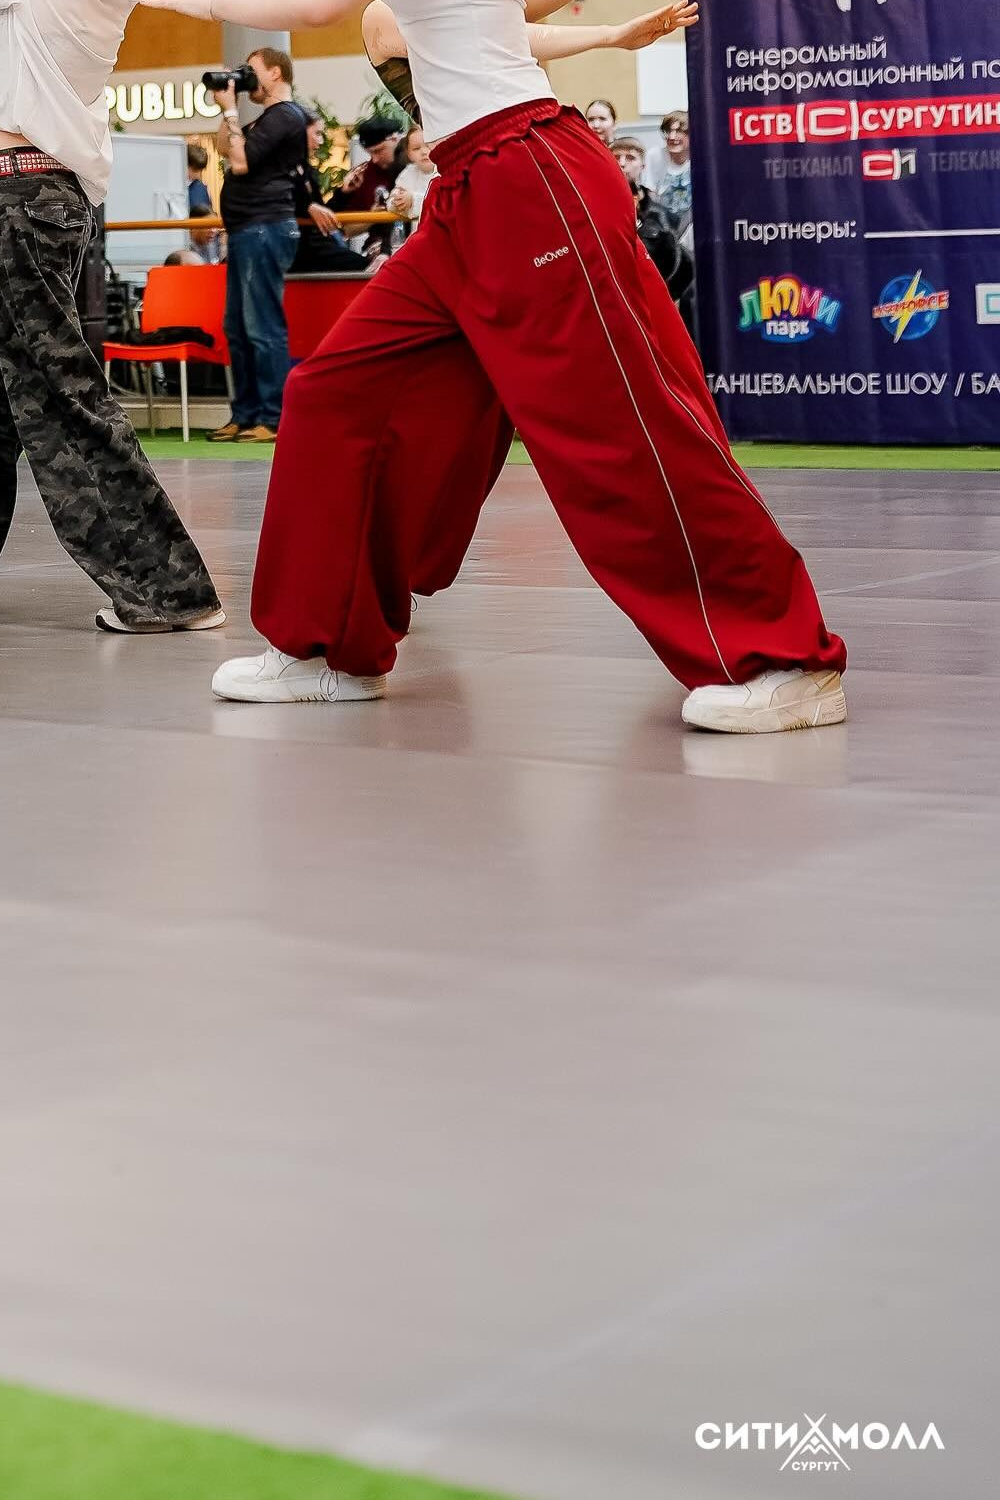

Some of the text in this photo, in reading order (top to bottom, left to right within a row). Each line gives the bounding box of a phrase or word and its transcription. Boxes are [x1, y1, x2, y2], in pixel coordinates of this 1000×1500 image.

[726, 35, 887, 69] Генеральный
[727, 56, 964, 96] информационный
[763, 156, 852, 180] ТЕЛЕКАНАЛ
[734, 220, 857, 244] Партнеры:
[534, 246, 569, 268] BeOvee
[766, 319, 810, 339] парк
[886, 371, 948, 395] ШОУ
